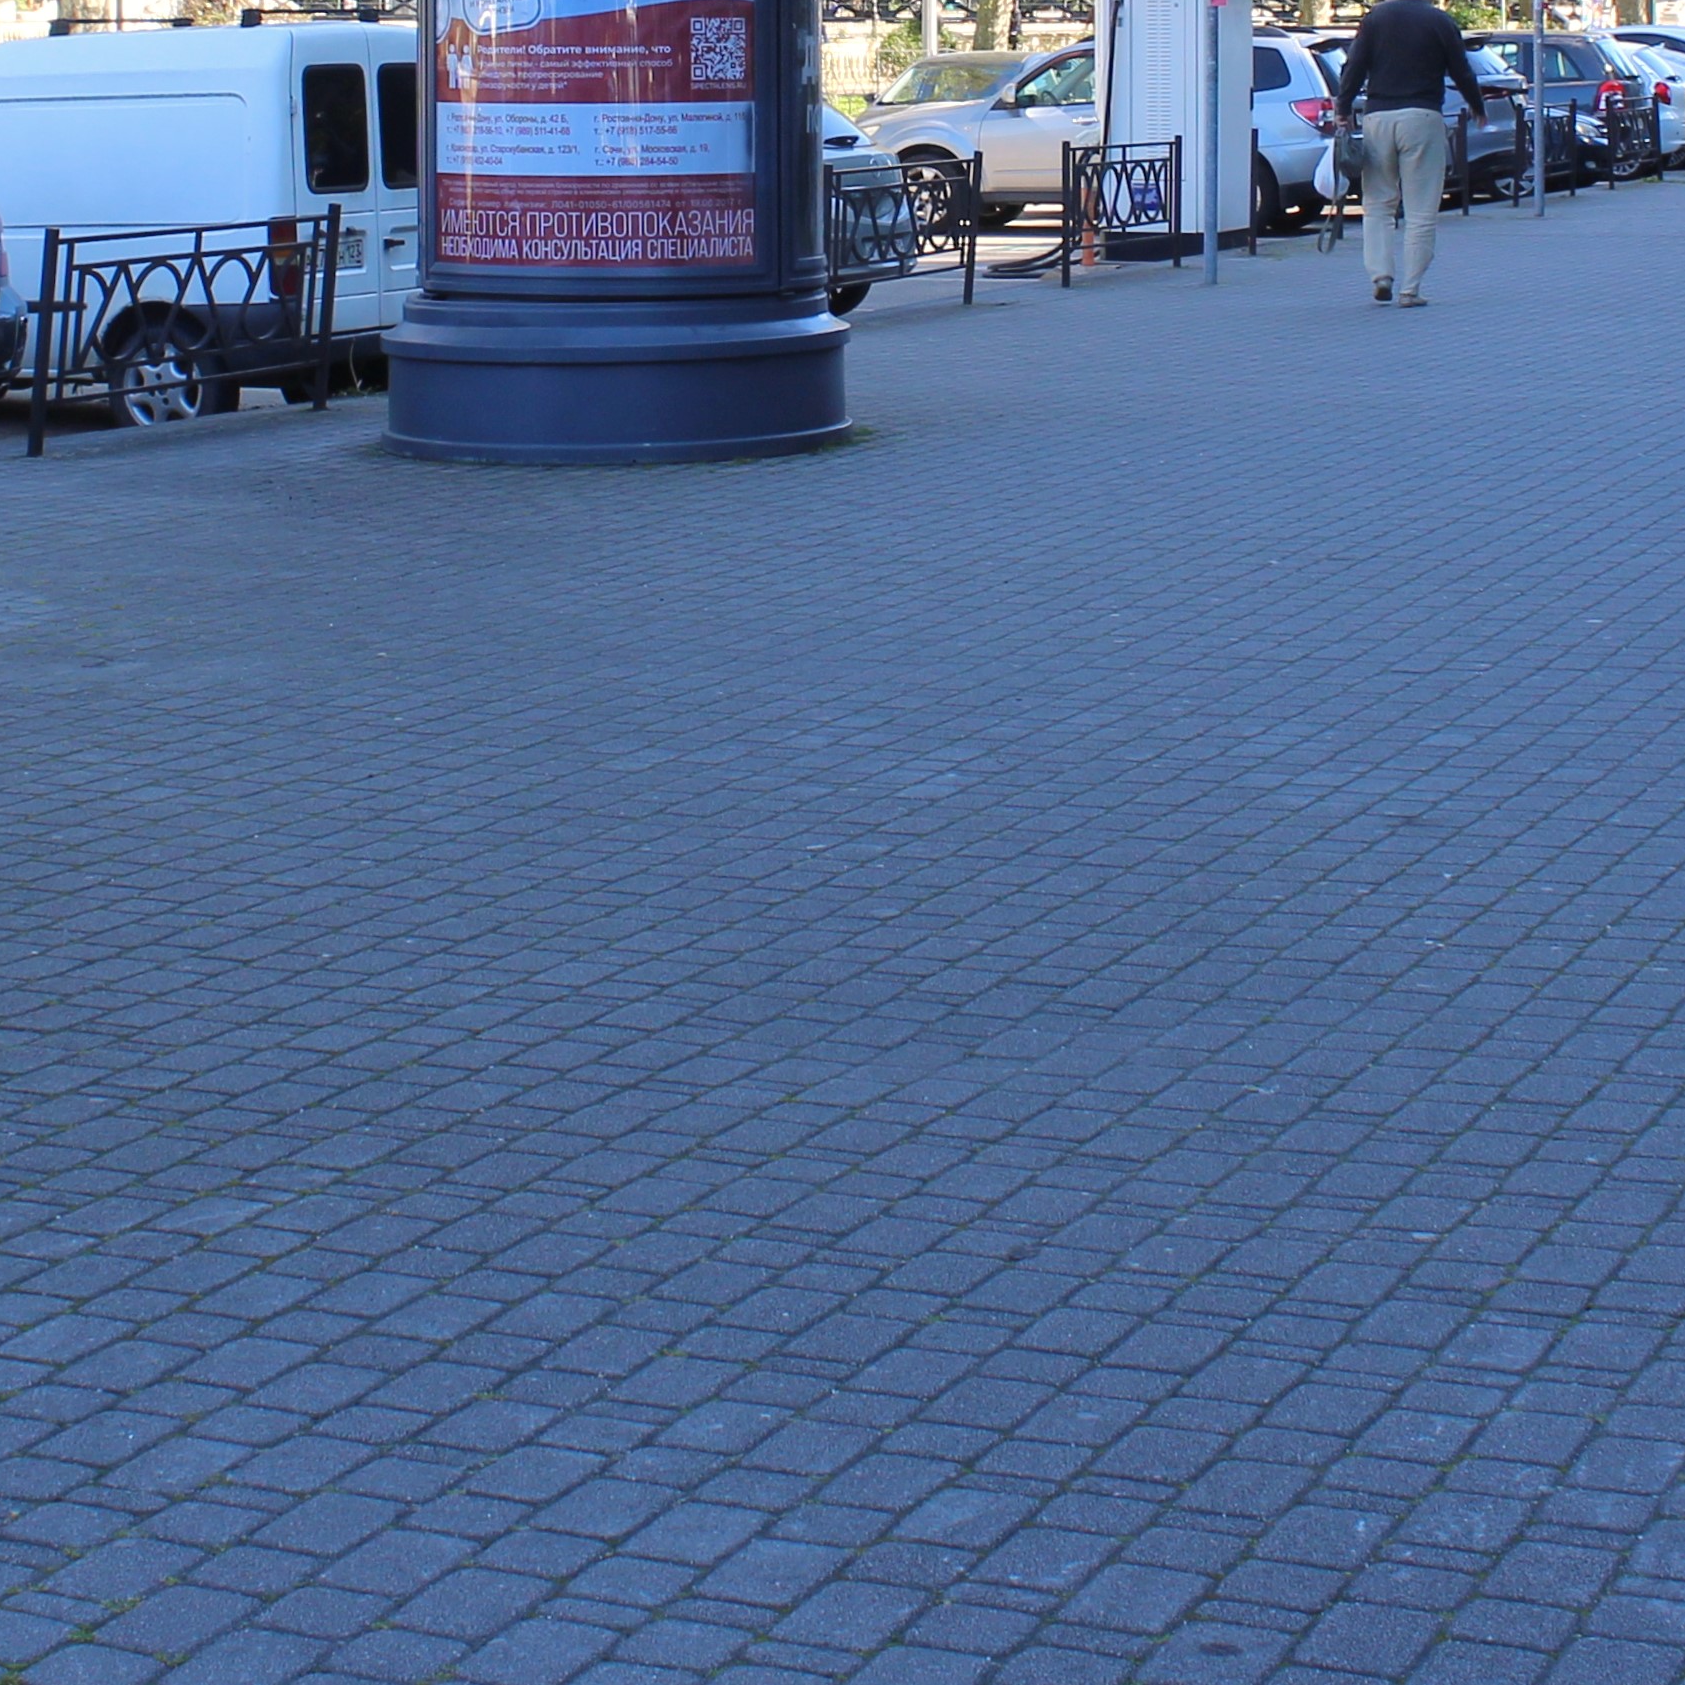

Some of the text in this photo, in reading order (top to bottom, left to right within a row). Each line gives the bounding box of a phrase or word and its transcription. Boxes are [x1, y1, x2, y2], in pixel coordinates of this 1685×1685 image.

[528, 44, 582, 56] Обратите
[585, 44, 649, 55] внимание,
[651, 45, 672, 54] что
[539, 58, 570, 68] самый
[571, 59, 637, 69] эффективный
[639, 58, 673, 68] способ
[518, 70, 604, 80] прогрессирование
[505, 114, 539, 124] Обороны,
[549, 114, 559, 123] 42
[601, 114, 666, 124] Ростов-на-Дону,
[668, 115, 680, 124] ул.
[605, 125, 615, 134] +7
[490, 144, 546, 155] Старокубанская,
[640, 144, 688, 153] Московская,
[606, 157, 615, 166] +7
[675, 199, 686, 208] от
[441, 208, 755, 238] ИМЕЮТСЯ ПРОТИВОПОКАЗАНИЯ
[441, 236, 754, 262] НЕОБХОДИМА КОНСУЛЬТАЦИЯ СПЕЦИАЛИСТА
